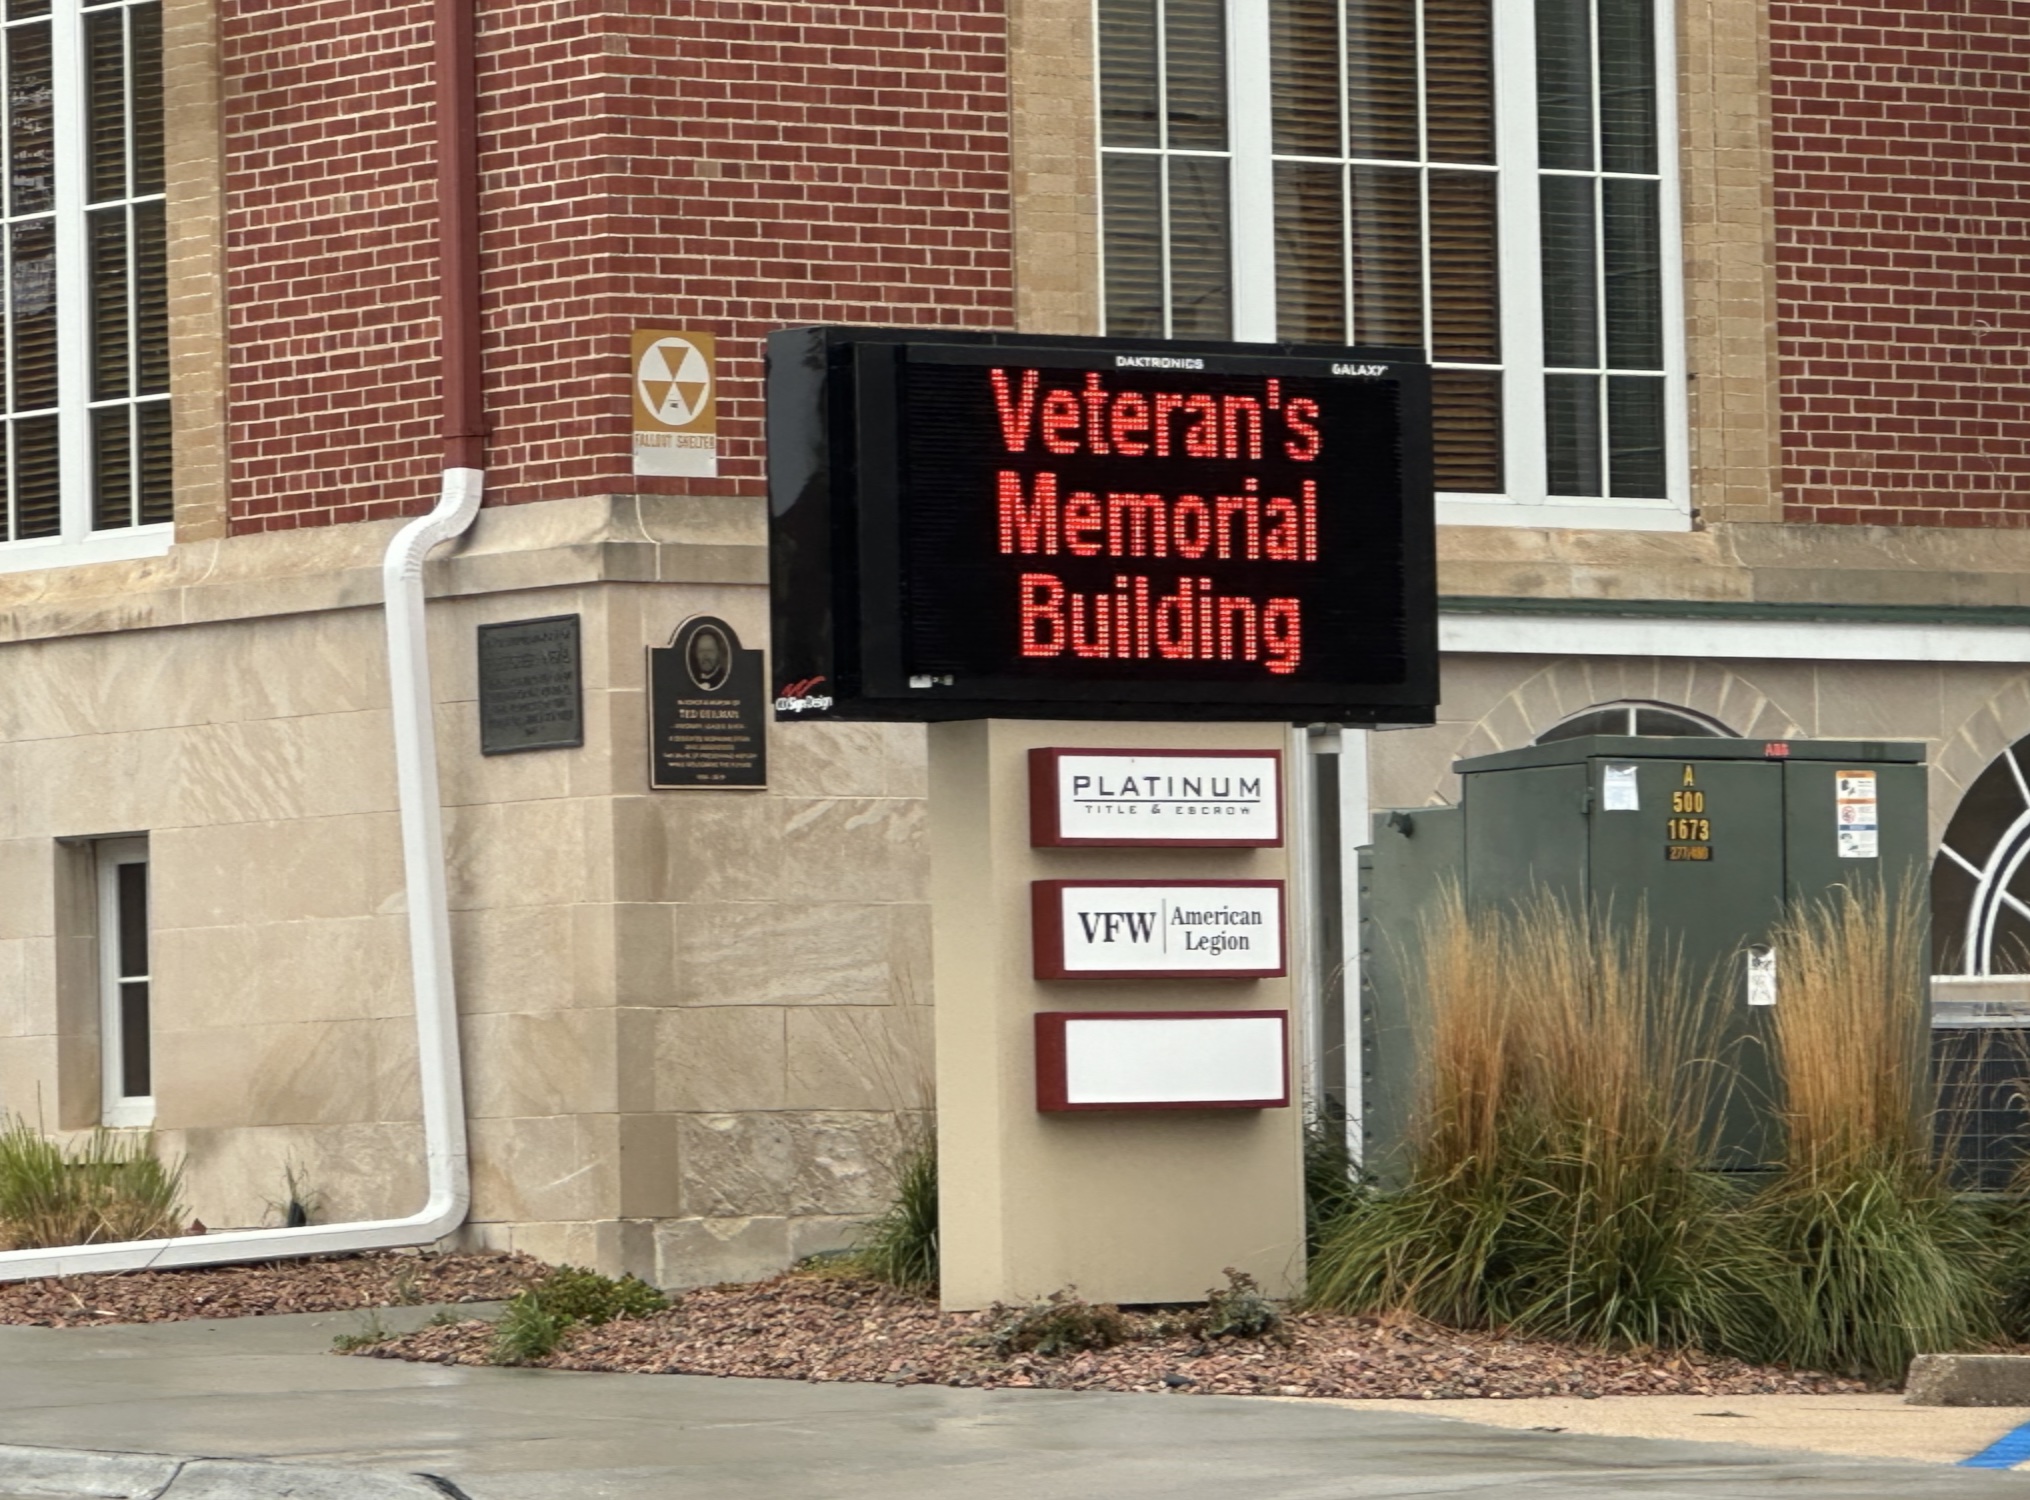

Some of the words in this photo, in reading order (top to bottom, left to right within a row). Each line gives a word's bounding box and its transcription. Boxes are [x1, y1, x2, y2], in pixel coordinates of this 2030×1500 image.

[1115, 356, 1205, 370] DAKTRONICS
[1331, 363, 1386, 377] GALAXY
[990, 368, 1322, 462] Veteran's
[635, 433, 673, 448] FALLOUT
[676, 435, 716, 450] SHELTER
[998, 470, 1317, 561] Memorial
[1020, 572, 1301, 674] Building
[1073, 775, 1261, 798] PLATINUM
[1683, 764, 1694, 787] A
[1085, 805, 1138, 815] TITLE
[1151, 803, 1162, 815] &
[1175, 805, 1251, 816] ESCROW
[1672, 791, 1704, 813] 500
[1667, 818, 1710, 840] 1673
[1170, 905, 1263, 926] American
[1077, 911, 1157, 944] VFW
[1184, 930, 1251, 956] Legion
